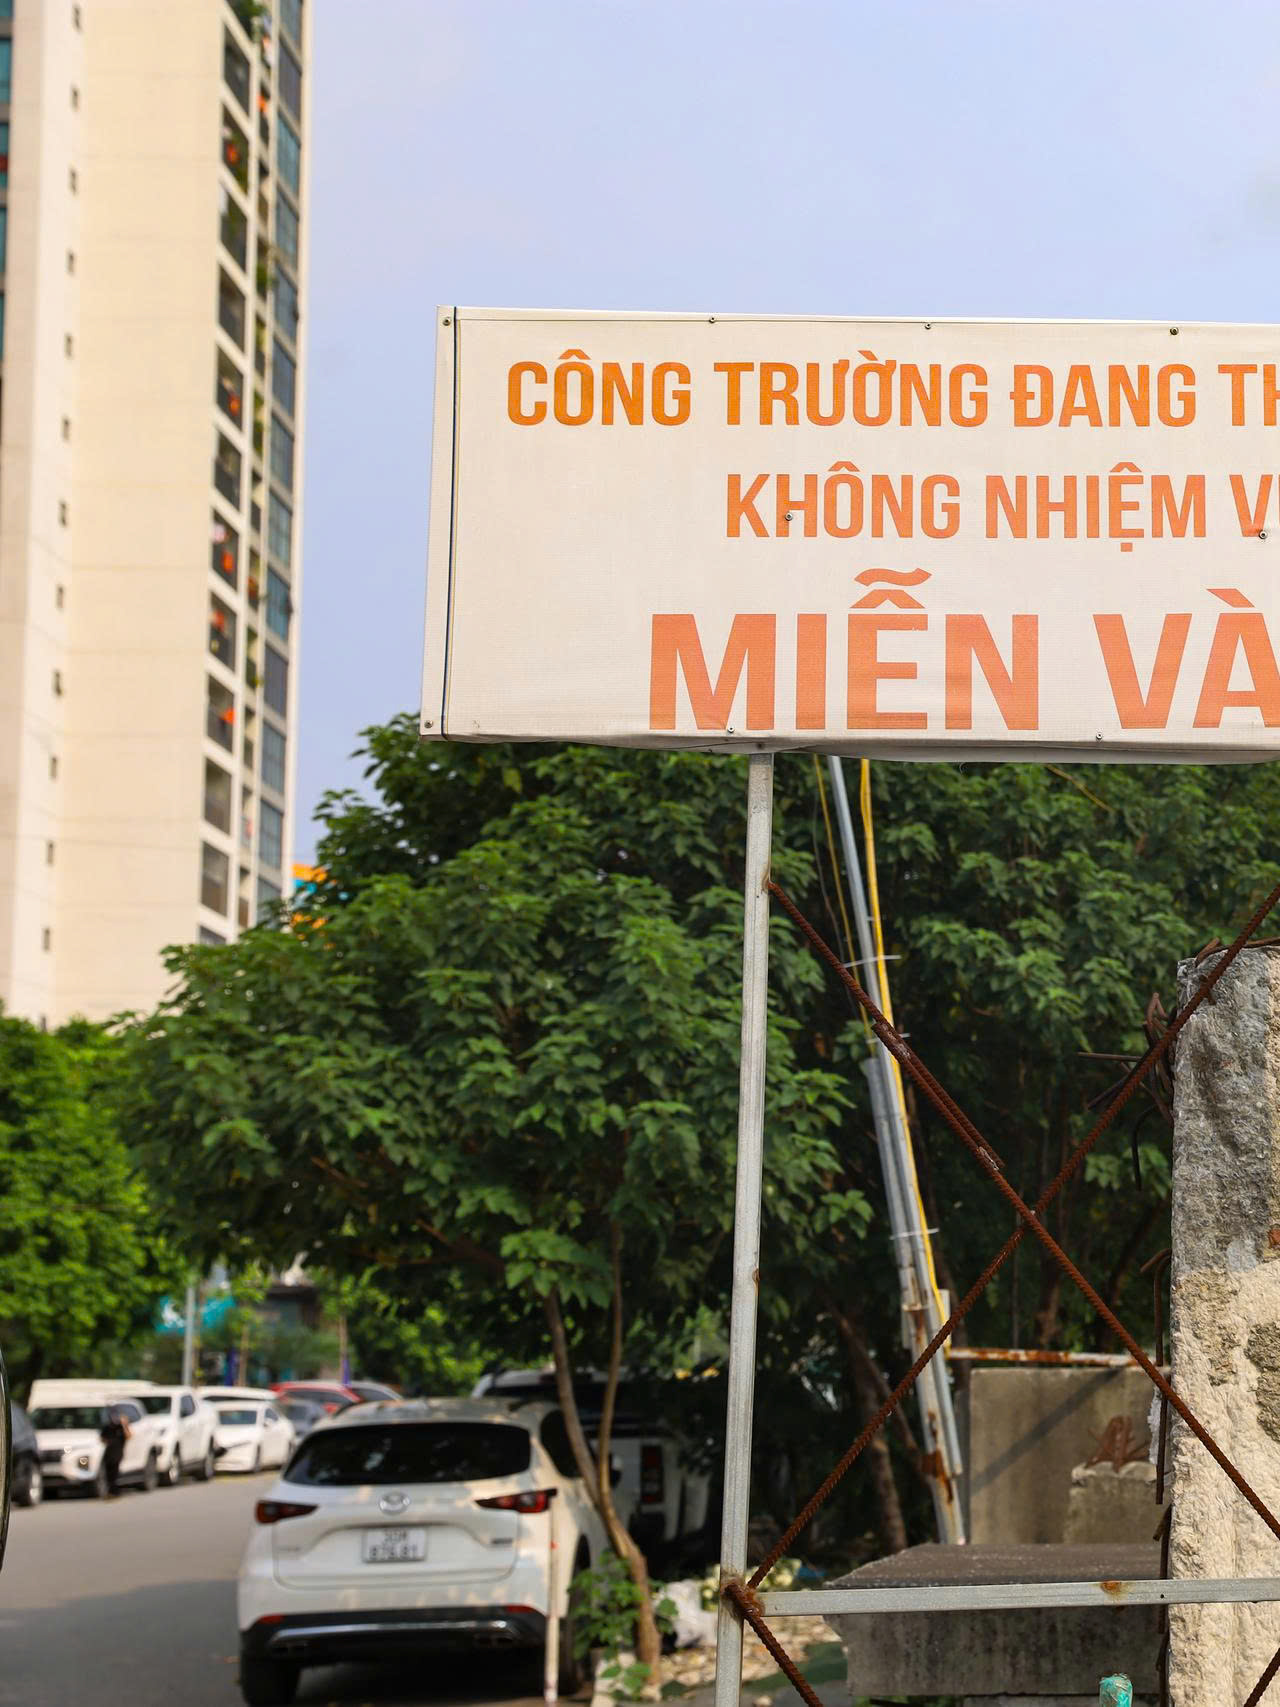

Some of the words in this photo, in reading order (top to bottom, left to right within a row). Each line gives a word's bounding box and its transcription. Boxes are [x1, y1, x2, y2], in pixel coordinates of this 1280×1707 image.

[507, 348, 692, 428] CÔNG
[712, 349, 989, 428] TRƯỜNG
[1009, 363, 1197, 428] ĐANG
[726, 461, 961, 540] KHÔNG
[984, 462, 1207, 553] NHIỆM
[648, 567, 1040, 732] MIỄN
